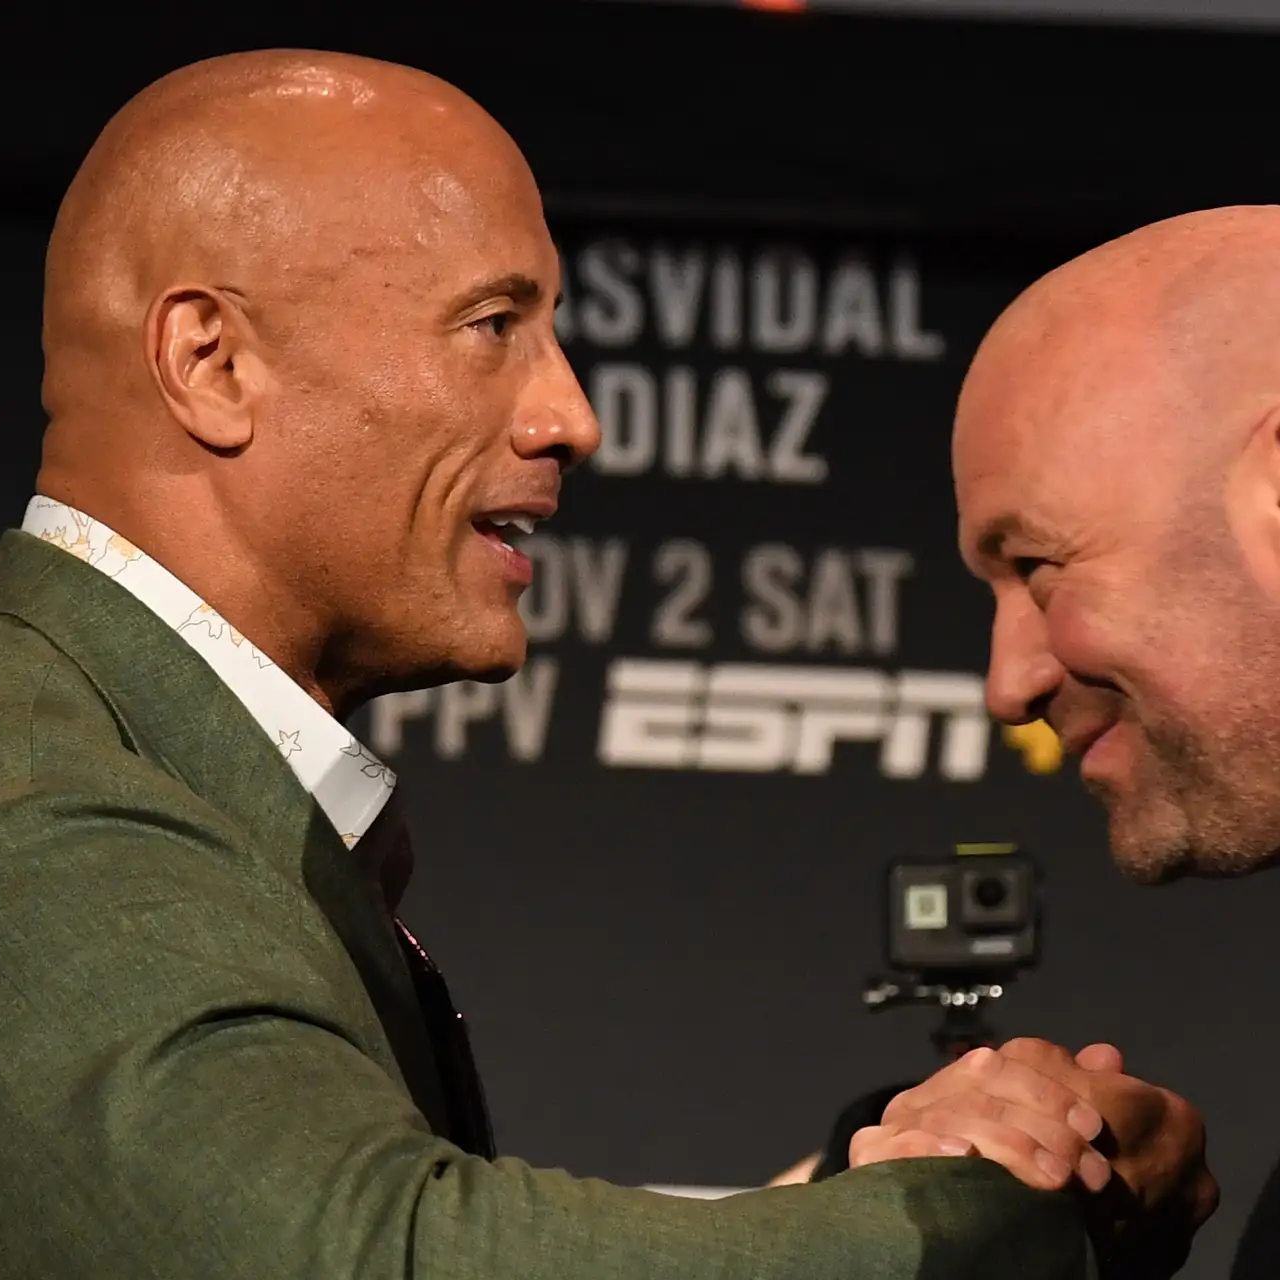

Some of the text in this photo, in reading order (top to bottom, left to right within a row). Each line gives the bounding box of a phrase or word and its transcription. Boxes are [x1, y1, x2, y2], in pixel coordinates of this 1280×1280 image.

[589, 361, 828, 483] DIAZ
[649, 537, 714, 648] 2
[740, 543, 912, 655] SAT
